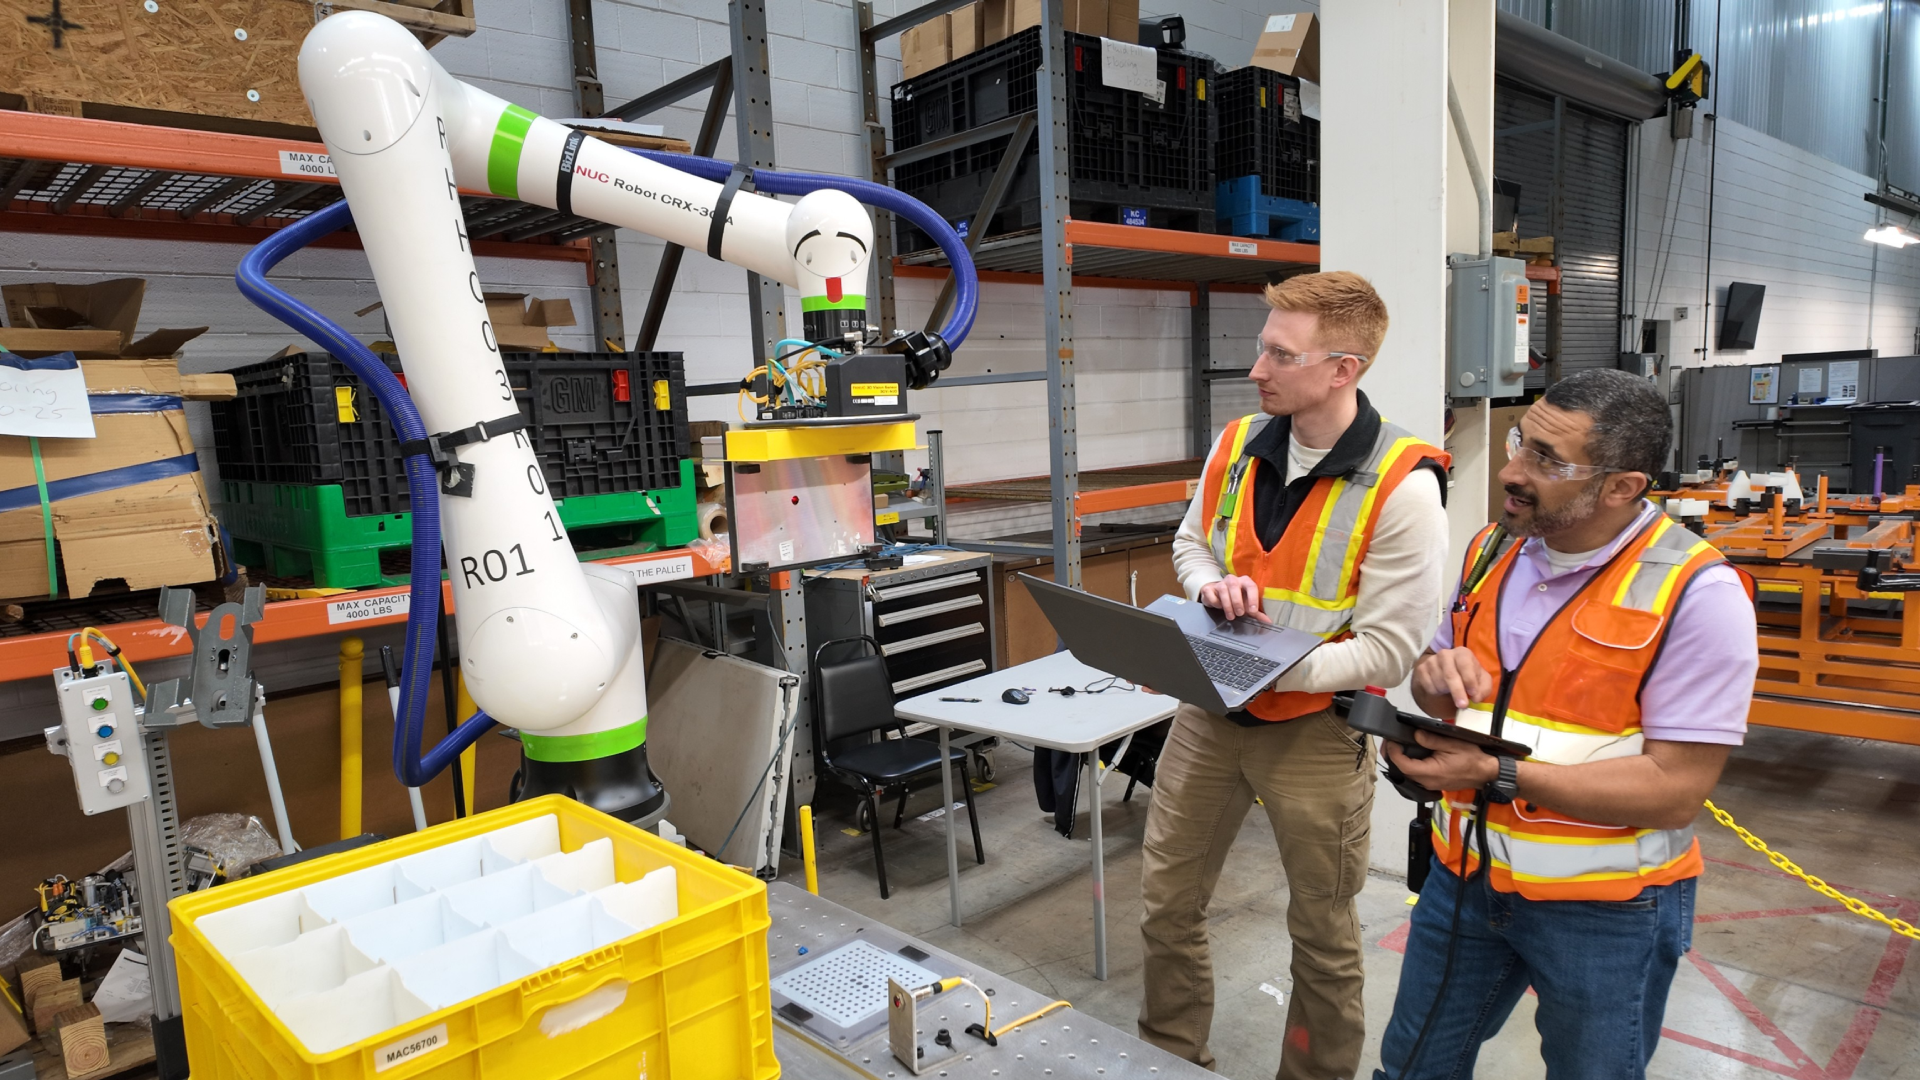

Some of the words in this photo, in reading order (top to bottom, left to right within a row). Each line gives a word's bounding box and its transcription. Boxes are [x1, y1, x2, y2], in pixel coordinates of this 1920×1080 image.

[289, 152, 314, 163] MAX
[560, 137, 580, 173] BizLink
[299, 164, 324, 174] 4000
[573, 165, 610, 184] NUC
[614, 178, 657, 201] Robot
[550, 377, 597, 414] GM
[636, 568, 654, 578] THE
[655, 564, 687, 575] PALLET
[336, 601, 360, 612] MAX
[346, 609, 370, 619] 4000
[372, 605, 393, 616] LBS
[386, 1034, 438, 1063] MAC56700
